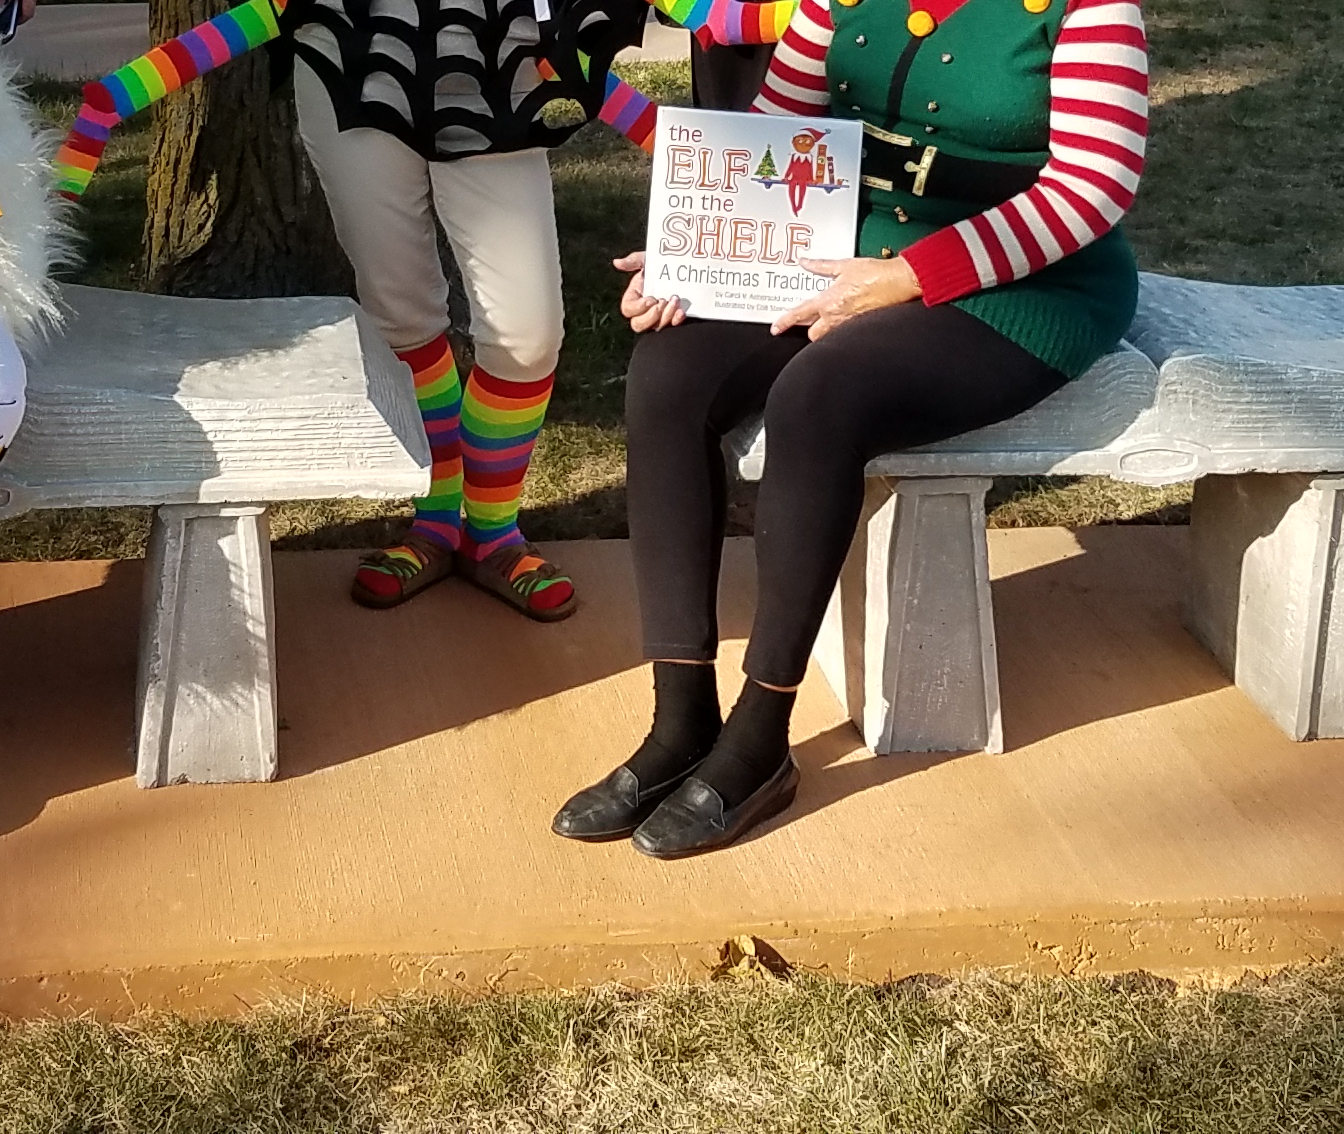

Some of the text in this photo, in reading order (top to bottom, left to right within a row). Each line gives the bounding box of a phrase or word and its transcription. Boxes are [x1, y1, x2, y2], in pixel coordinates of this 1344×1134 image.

[668, 124, 703, 143] the
[665, 145, 752, 194] ELF
[668, 194, 734, 212] on the
[659, 212, 814, 266] SHELF
[659, 263, 671, 281] A
[676, 265, 760, 288] Christmas
